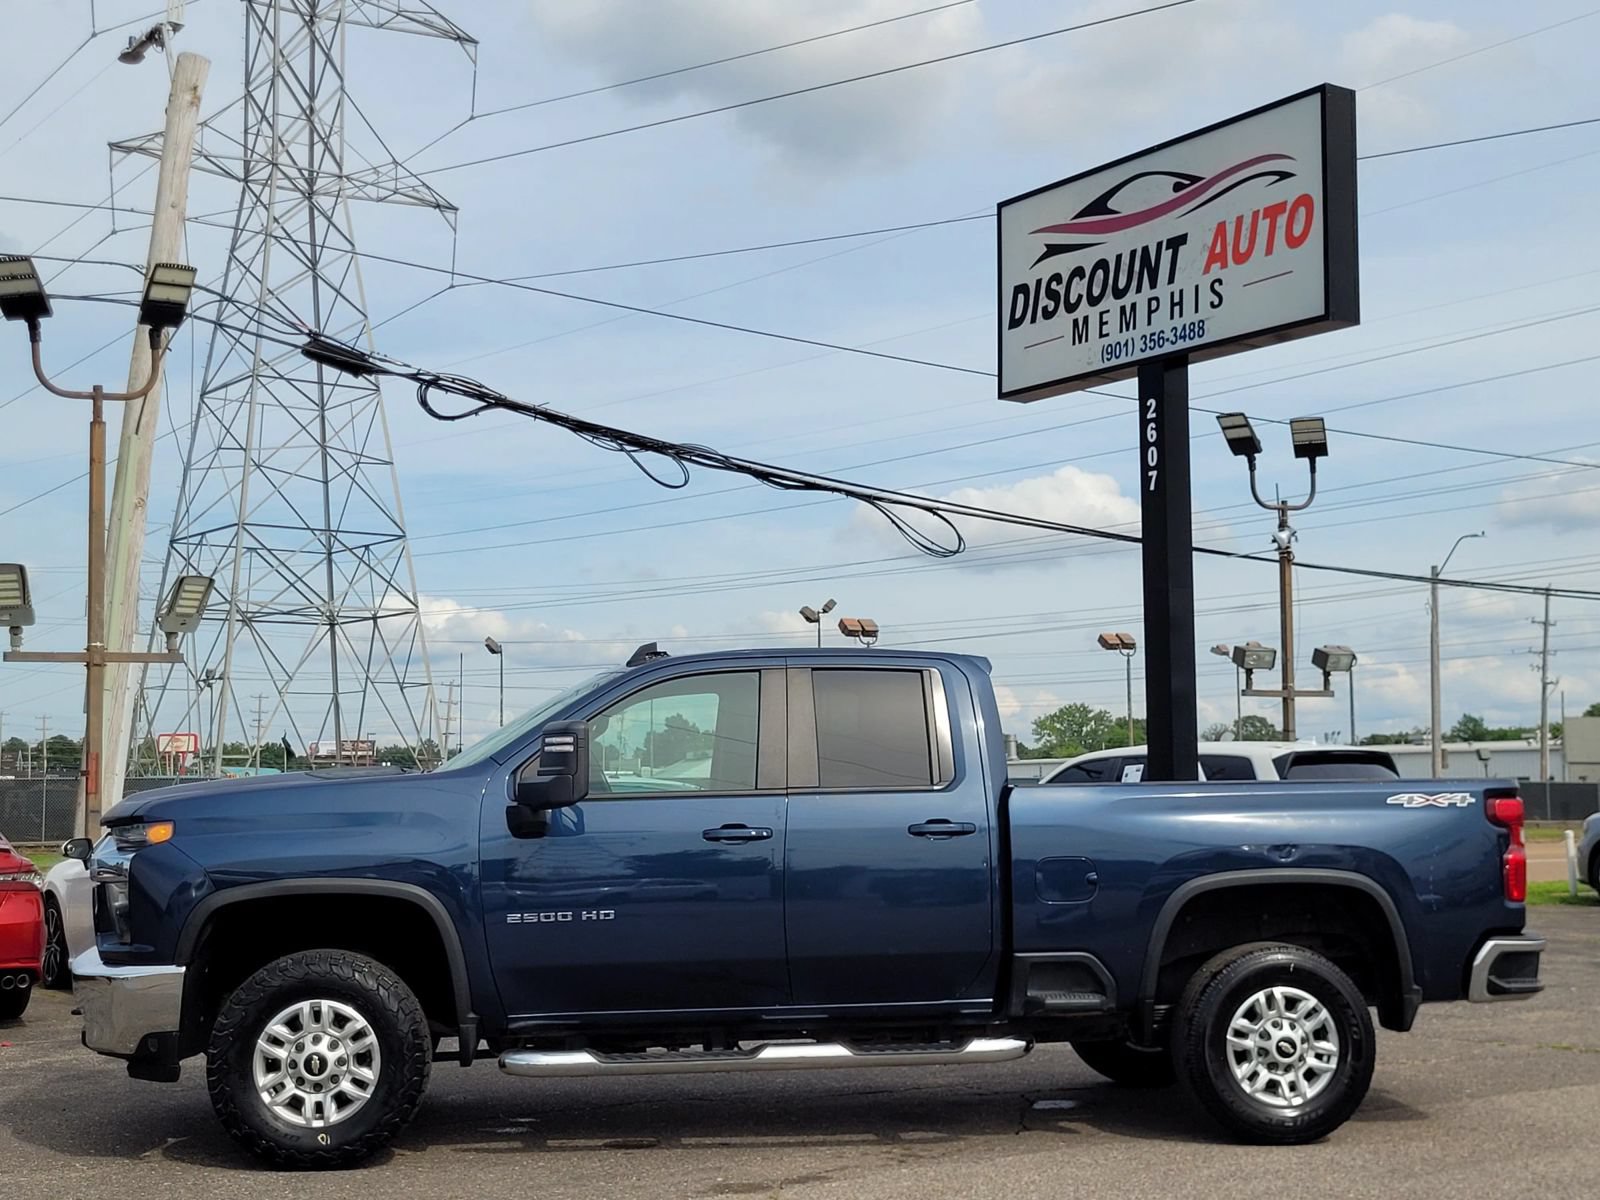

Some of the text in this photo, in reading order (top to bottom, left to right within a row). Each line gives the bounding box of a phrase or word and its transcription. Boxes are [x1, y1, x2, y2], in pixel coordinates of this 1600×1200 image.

[1008, 193, 1314, 331] DISCOUNT AUTO
[1071, 278, 1224, 346] MEMPHIS
[1101, 319, 1206, 364] (901) 356-3488
[1146, 398, 1158, 491] 2607
[506, 910, 615, 924] 2500 HD
